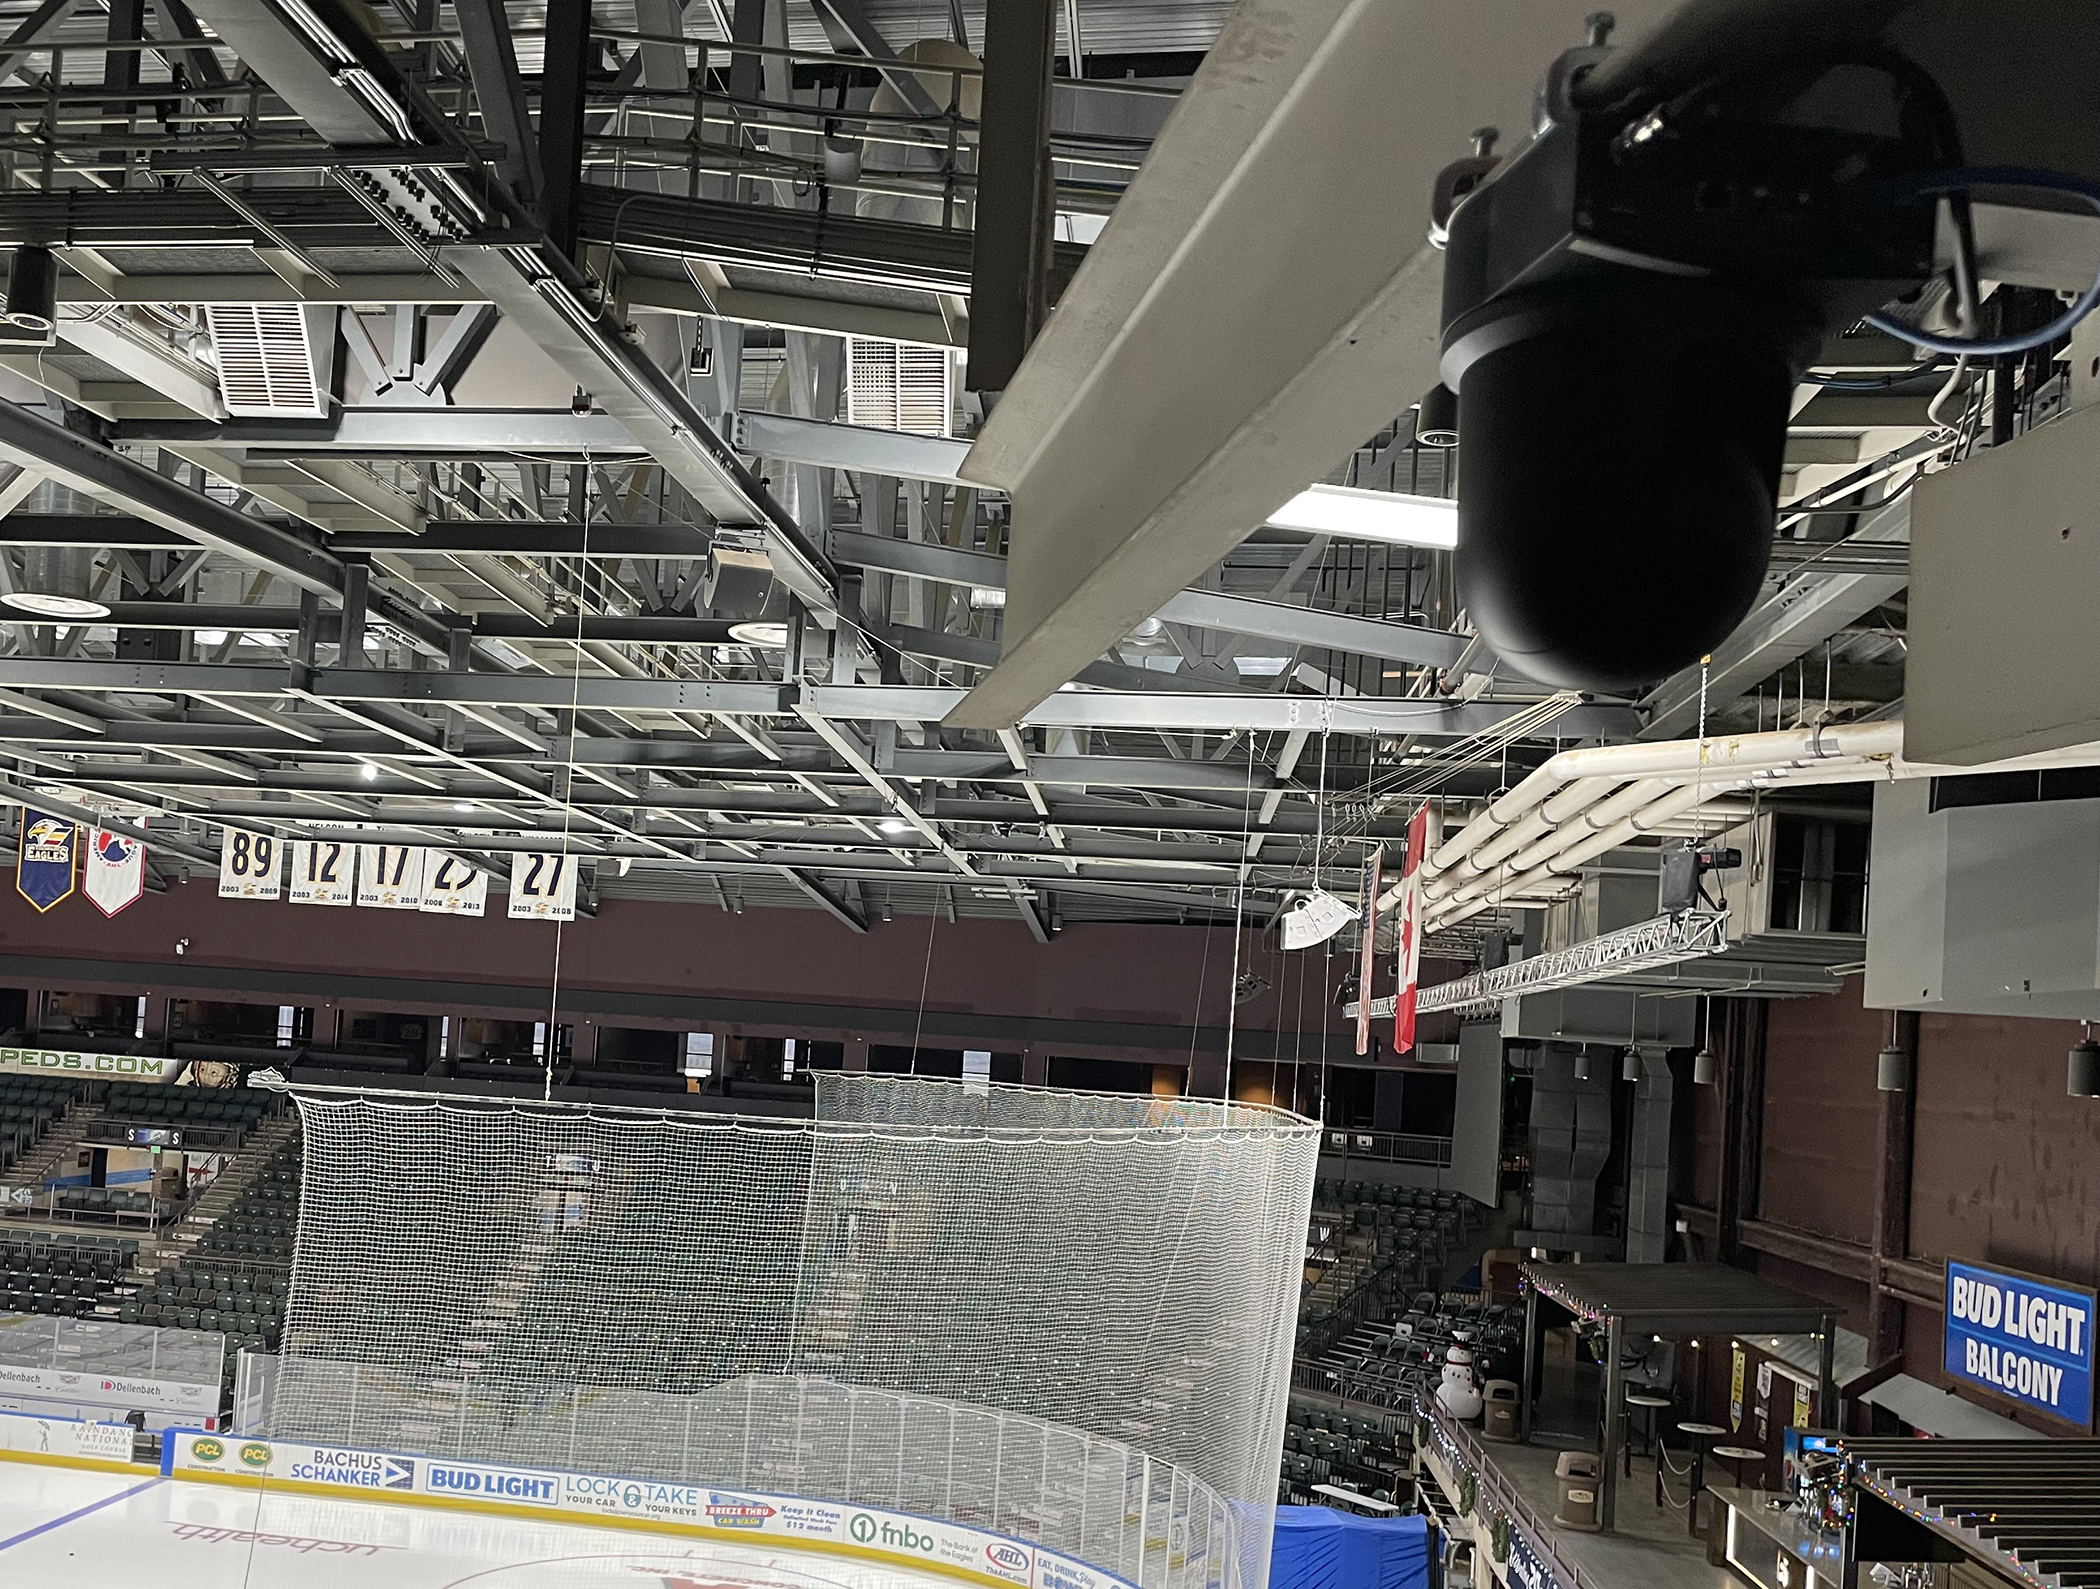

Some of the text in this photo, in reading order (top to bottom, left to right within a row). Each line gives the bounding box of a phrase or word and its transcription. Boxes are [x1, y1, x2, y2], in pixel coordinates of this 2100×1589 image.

[26, 845, 69, 861] EAGLES
[232, 832, 273, 878] 89
[308, 842, 341, 883] 12
[376, 846, 410, 886] 17
[522, 853, 564, 896] 27
[0, 1050, 163, 1075] PEDS.COM
[128, 1128, 135, 1141] S
[172, 1132, 180, 1145] S
[1953, 1276, 2086, 1355] BUD LIGHT
[1966, 1337, 2063, 1406] BALCONY
[116, 1382, 161, 1395] Dellenbach
[195, 1442, 220, 1456] PCL
[243, 1448, 268, 1461] PCL
[187, 1463, 226, 1472] CONSTRUCTION
[313, 1450, 382, 1470] BACHUS
[290, 1463, 381, 1486] SCHANKER
[431, 1469, 554, 1499] BUD LIGHT
[565, 1475, 620, 1497] LOCK
[645, 1484, 698, 1506] TAKE
[565, 1494, 616, 1508] YOUR CAR
[645, 1503, 697, 1517] YOUR KEYS
[709, 1506, 769, 1516] BREEZE THRU
[780, 1505, 804, 1515] Keep
[816, 1509, 841, 1519] Clean
[718, 1517, 760, 1526] CAR WASH
[786, 1521, 833, 1533] $12 month
[172, 1523, 380, 1556] uchealth
[881, 1520, 934, 1552] fnbo
[940, 1538, 979, 1553] The Bank of
[940, 1548, 974, 1563] the Eagles
[993, 1547, 1023, 1567] AHL
[1037, 1557, 1053, 1573] EAT,
[985, 1565, 1028, 1584] TheAHL.com
